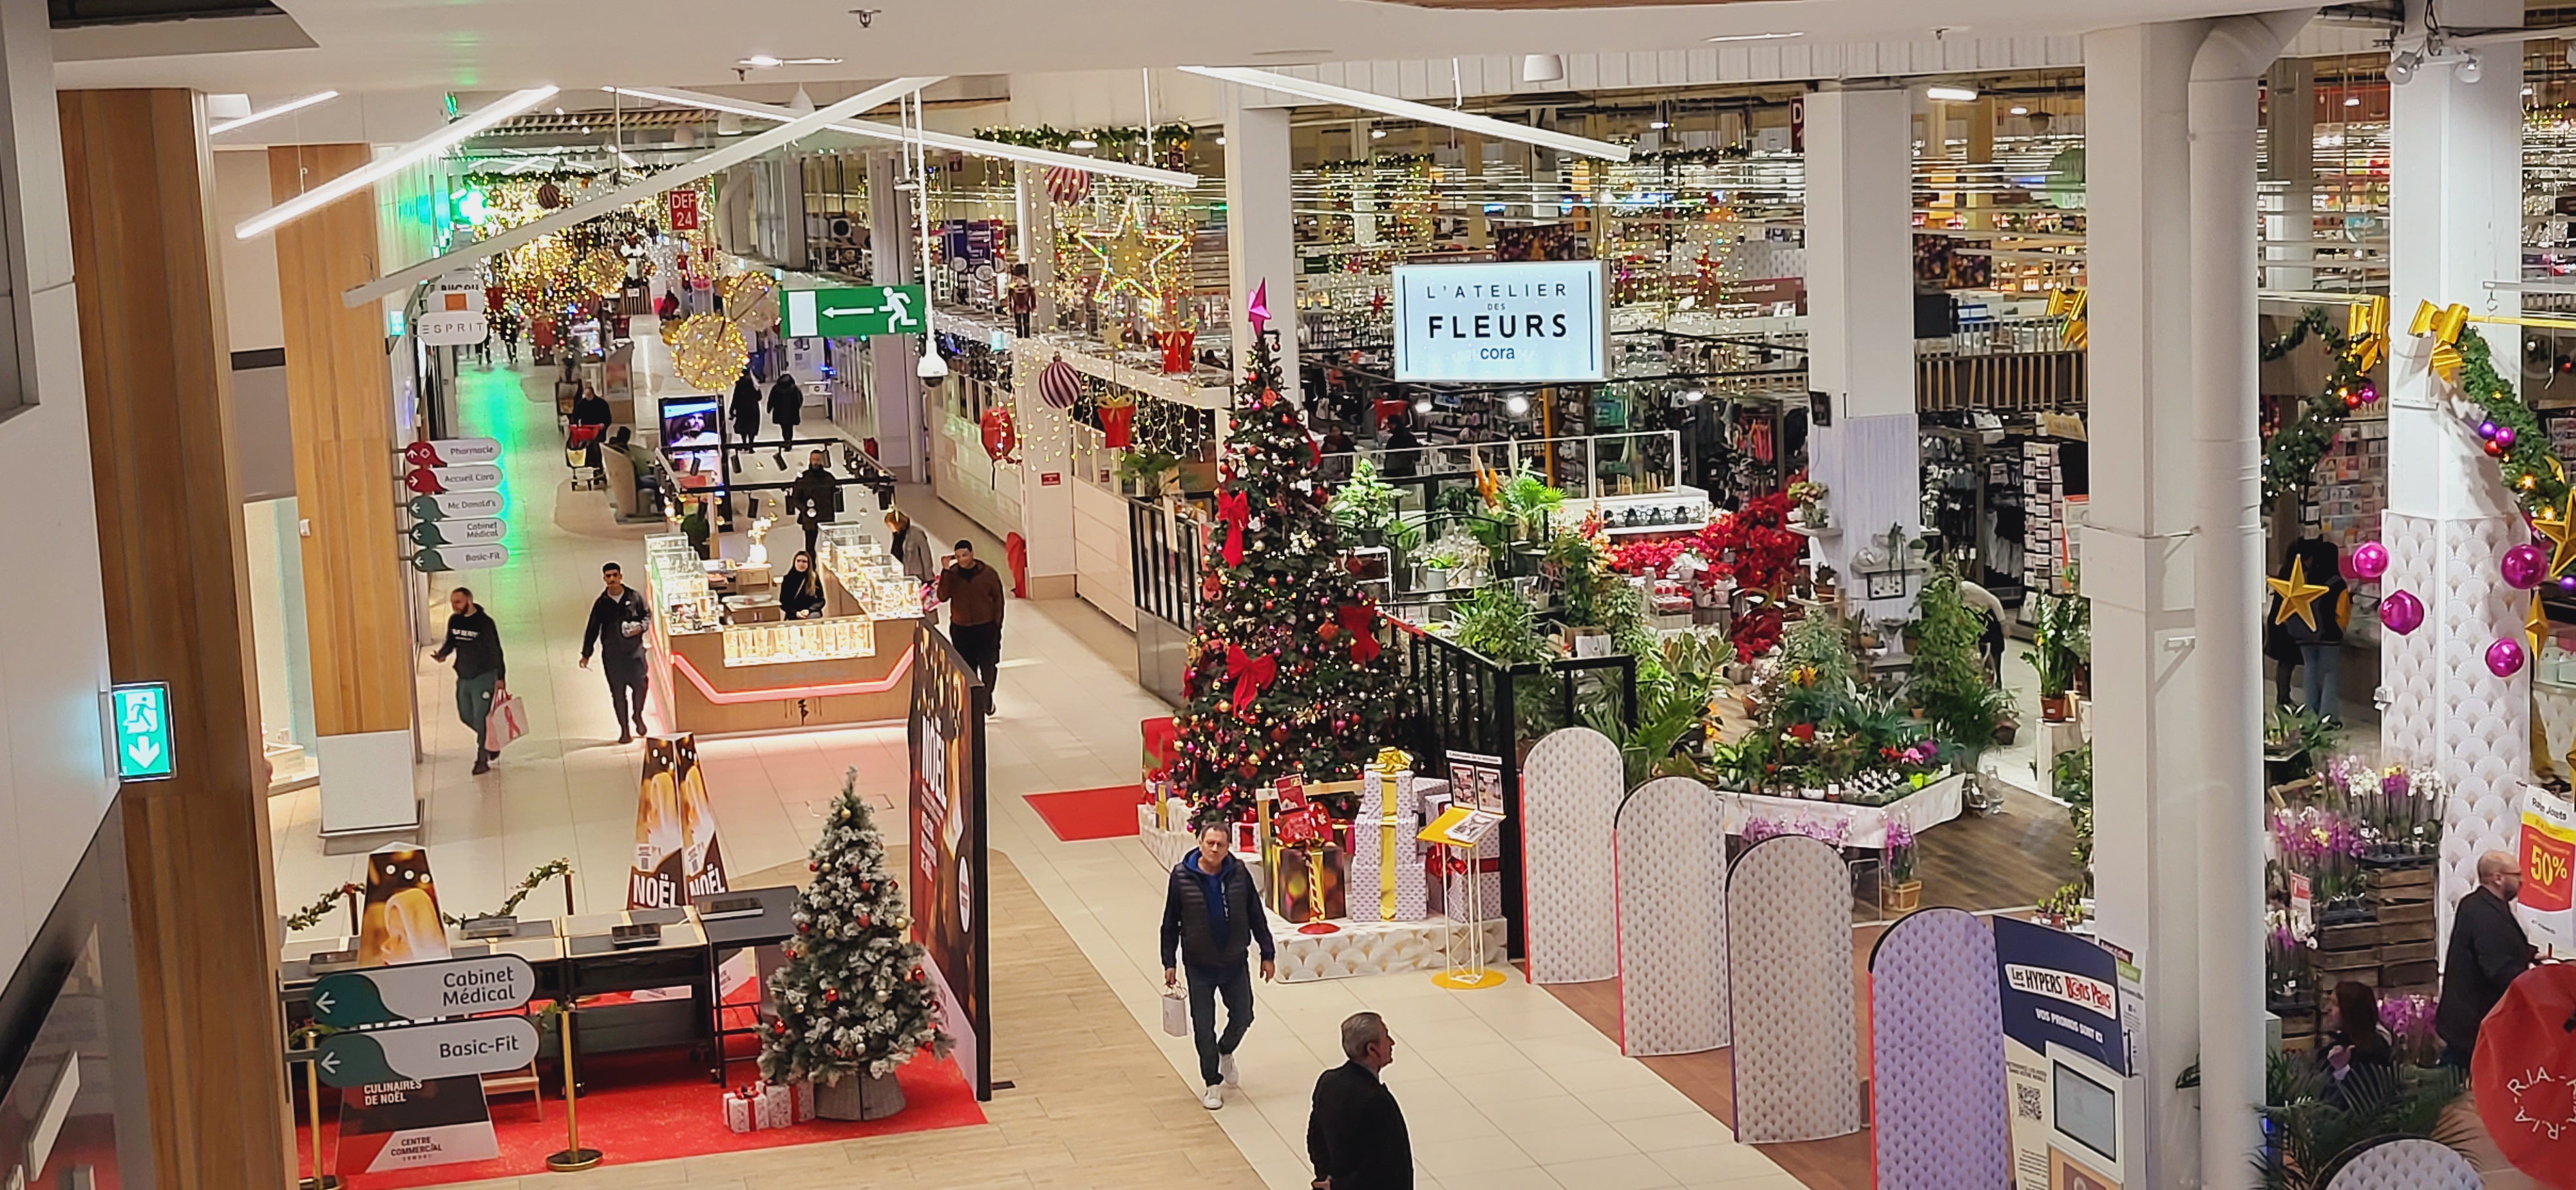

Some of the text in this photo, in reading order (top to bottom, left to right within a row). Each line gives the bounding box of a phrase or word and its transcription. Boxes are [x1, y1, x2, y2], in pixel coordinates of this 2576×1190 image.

[672, 193, 694, 209] DEF
[677, 211, 692, 226] 24
[1427, 283, 1566, 299] L'ATELIER
[1487, 303, 1506, 311] DES
[422, 323, 483, 334] ESPRIT
[1429, 314, 1567, 339] FLEURS
[1481, 346, 1515, 360] cora
[450, 446, 493, 455] Pharmacie
[444, 474, 473, 482] Accueil
[462, 500, 496, 509] Donald's
[467, 522, 497, 530] Cabinet
[467, 529, 498, 538] Médical
[466, 552, 500, 562] Basic-Fit
[922, 715, 947, 810] NOËL
[2531, 845, 2568, 886] 50%
[689, 864, 725, 896] NOËL
[633, 873, 677, 909] NOËL
[443, 967, 515, 988] Cabinet
[2011, 968, 2024, 981] Les
[2025, 970, 2063, 995] HYPERS
[2065, 976, 2091, 1001] Bons
[442, 985, 516, 1006] Médical
[2035, 1008, 2050, 1022] VOS
[439, 1035, 519, 1058] Basic-Fit
[364, 1080, 422, 1094] CULINAIRES
[365, 1090, 407, 1106] DE NOËL
[401, 1137, 431, 1146] CENTRE
[391, 1144, 443, 1157] COMMERCIAL
